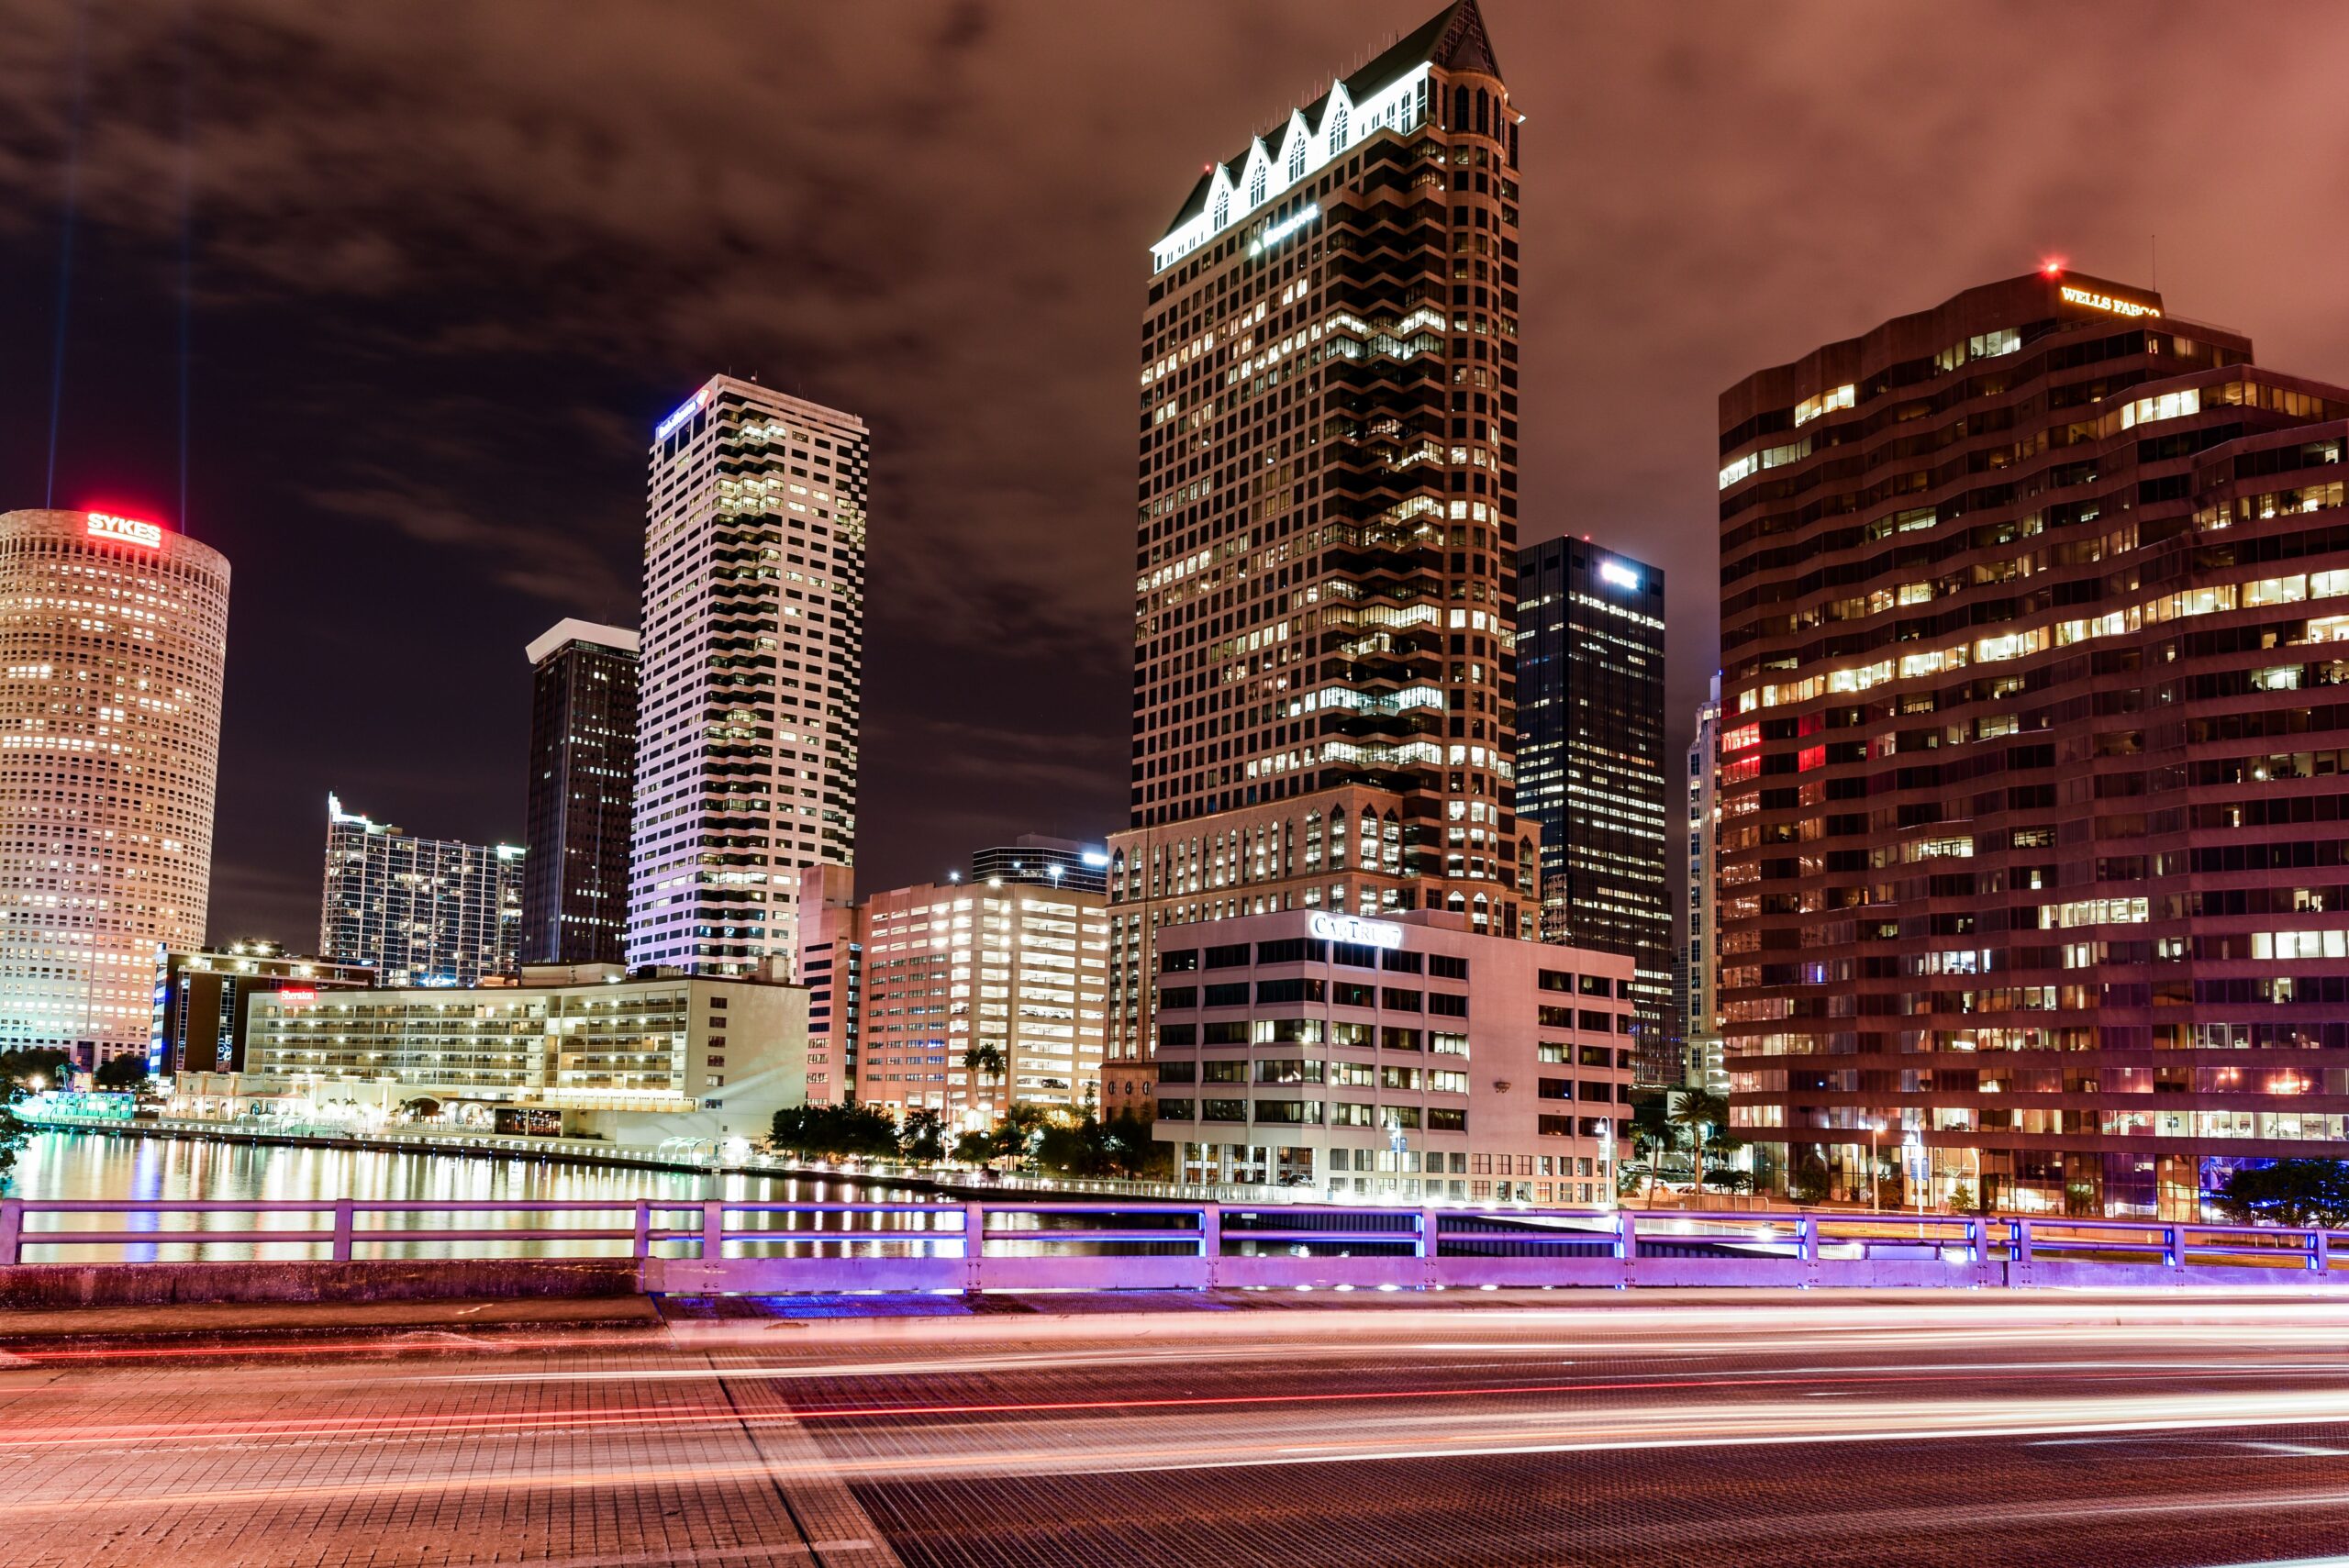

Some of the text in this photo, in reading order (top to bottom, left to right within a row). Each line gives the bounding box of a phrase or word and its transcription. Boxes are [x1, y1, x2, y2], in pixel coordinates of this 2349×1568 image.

[2061, 286, 2110, 310] WELLS
[88, 513, 161, 542] SYKES
[1314, 917, 1399, 945] CAPTRUT
